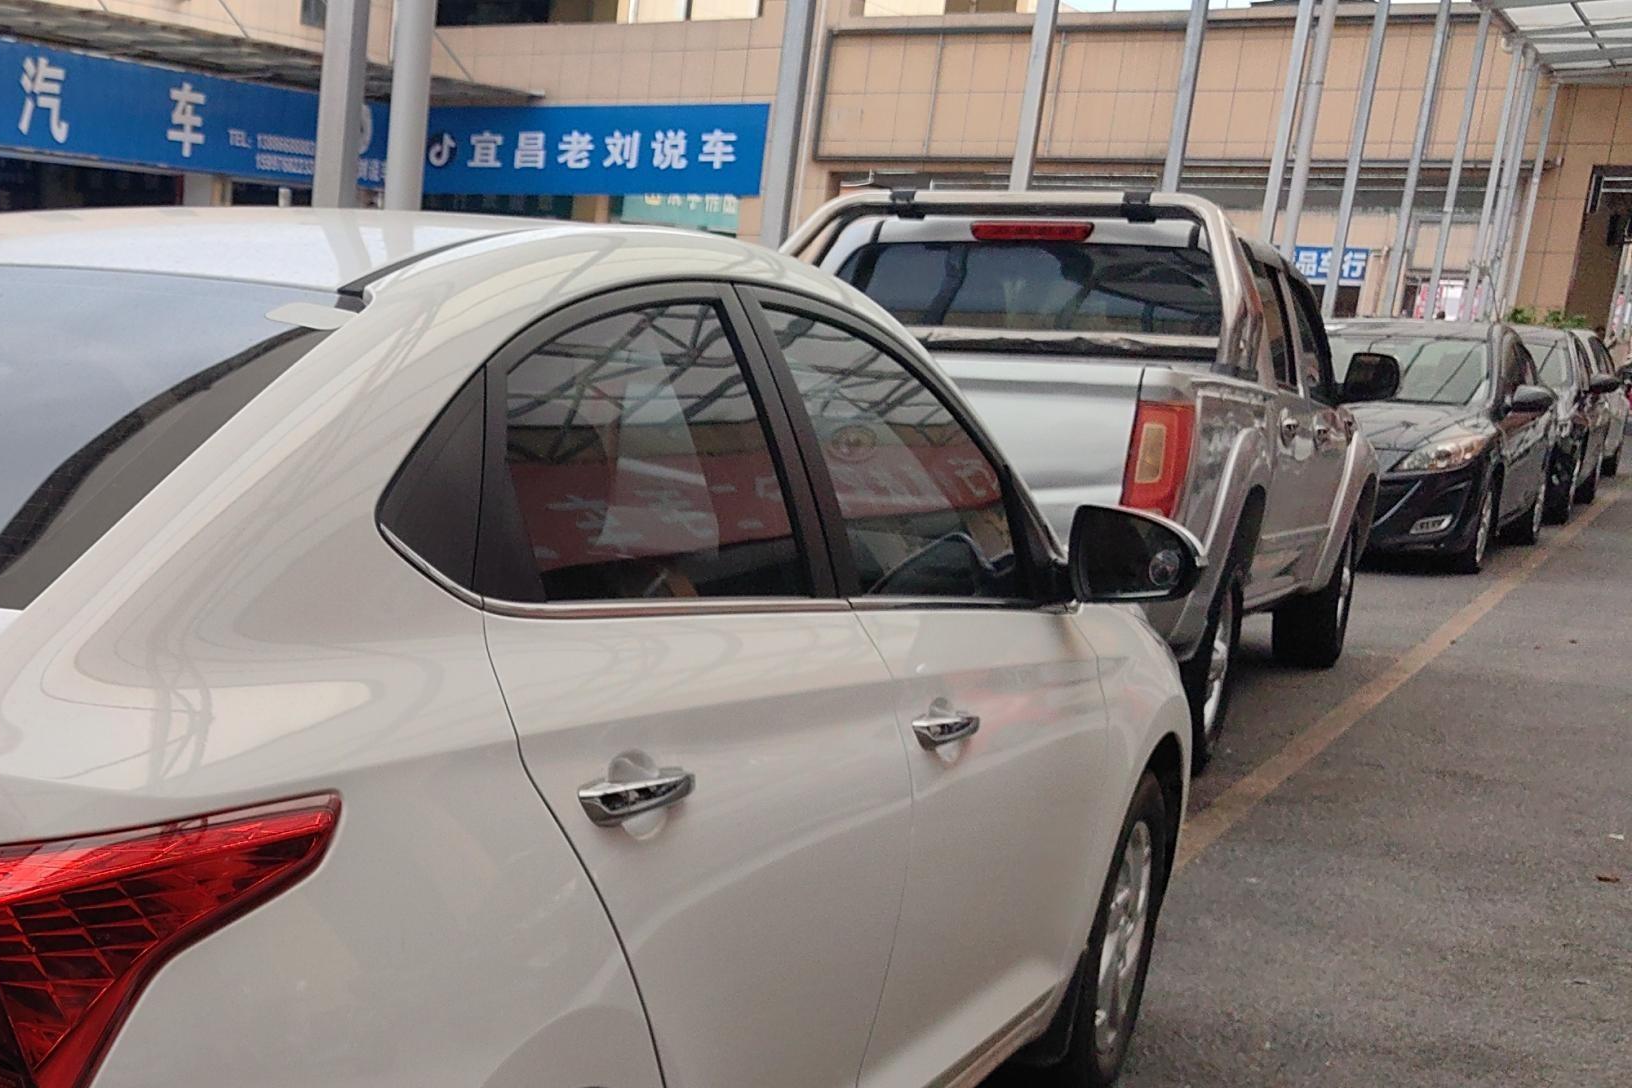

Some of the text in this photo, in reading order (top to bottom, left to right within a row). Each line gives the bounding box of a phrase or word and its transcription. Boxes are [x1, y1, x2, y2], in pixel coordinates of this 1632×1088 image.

[466, 129, 738, 170] 宜昌老刘说车
